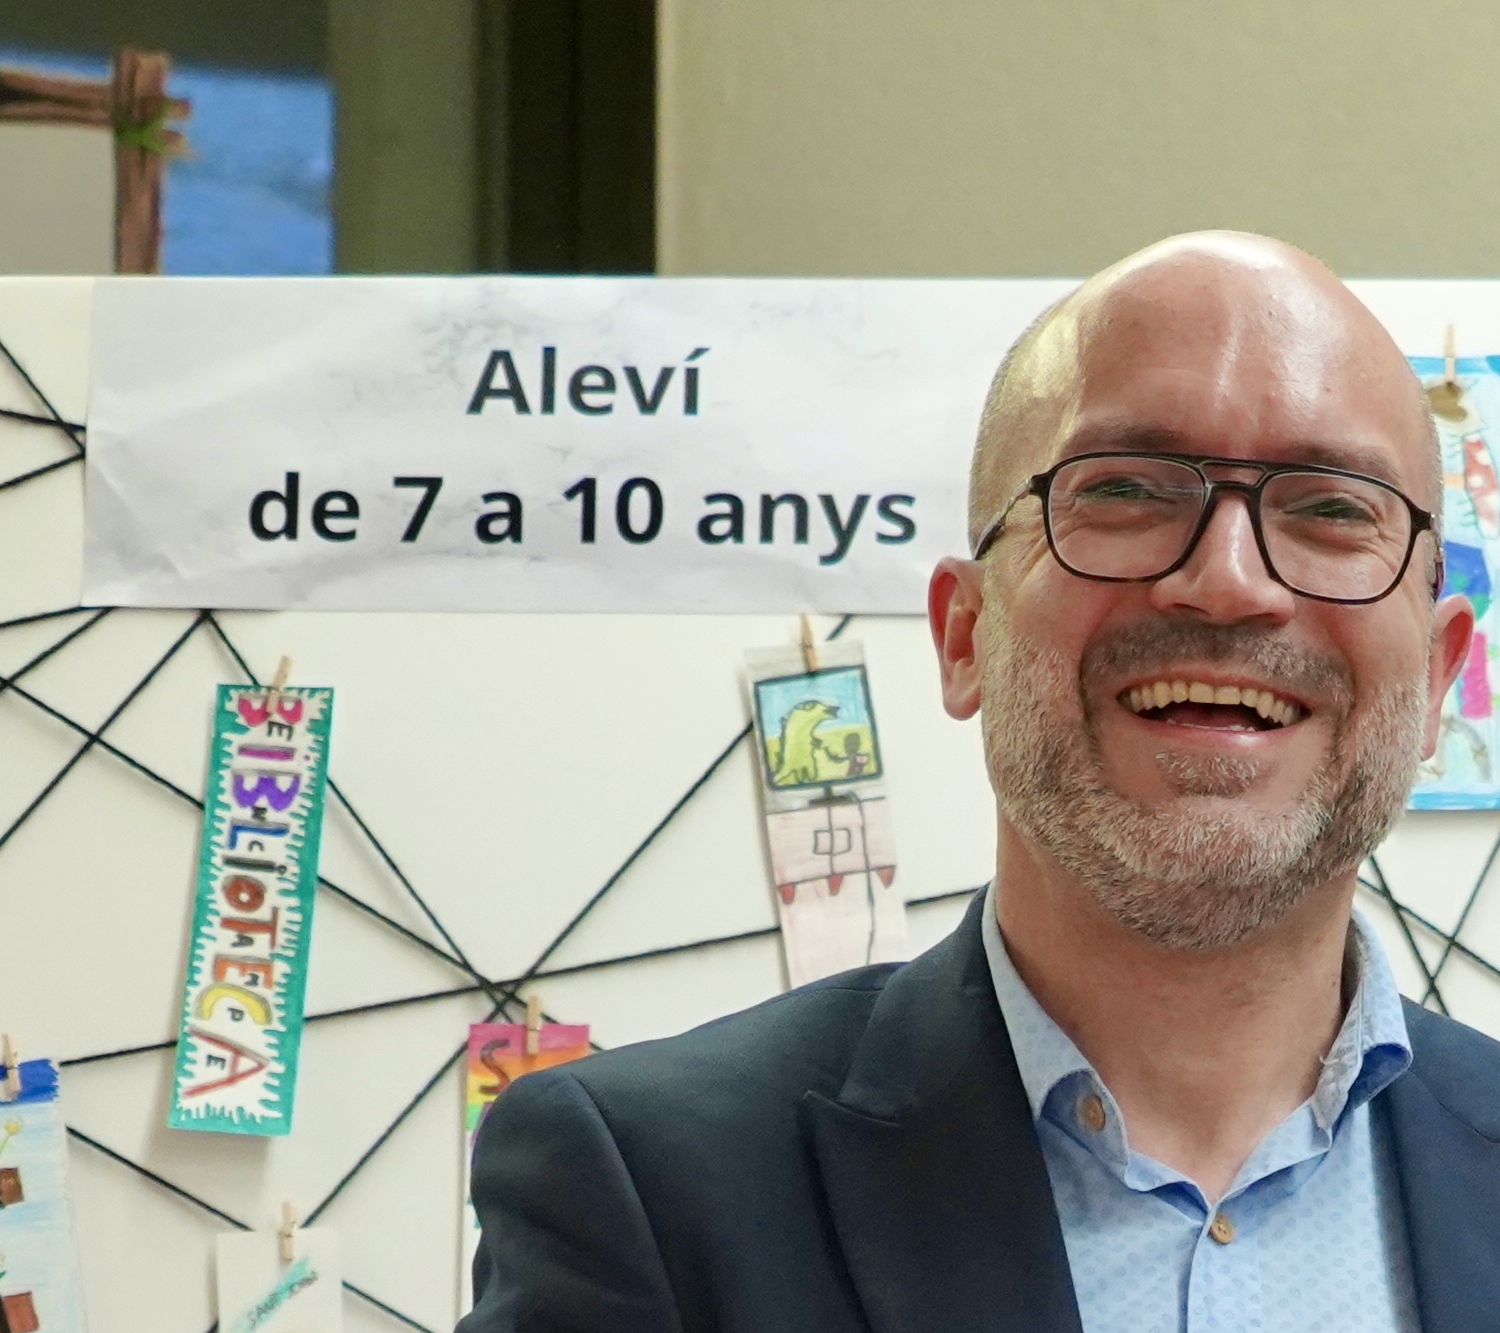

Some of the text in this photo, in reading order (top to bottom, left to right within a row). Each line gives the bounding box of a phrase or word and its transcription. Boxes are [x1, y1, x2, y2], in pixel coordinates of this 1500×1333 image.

[466, 346, 710, 417] Aleví
[248, 472, 917, 565] de 7 a 10 anys
